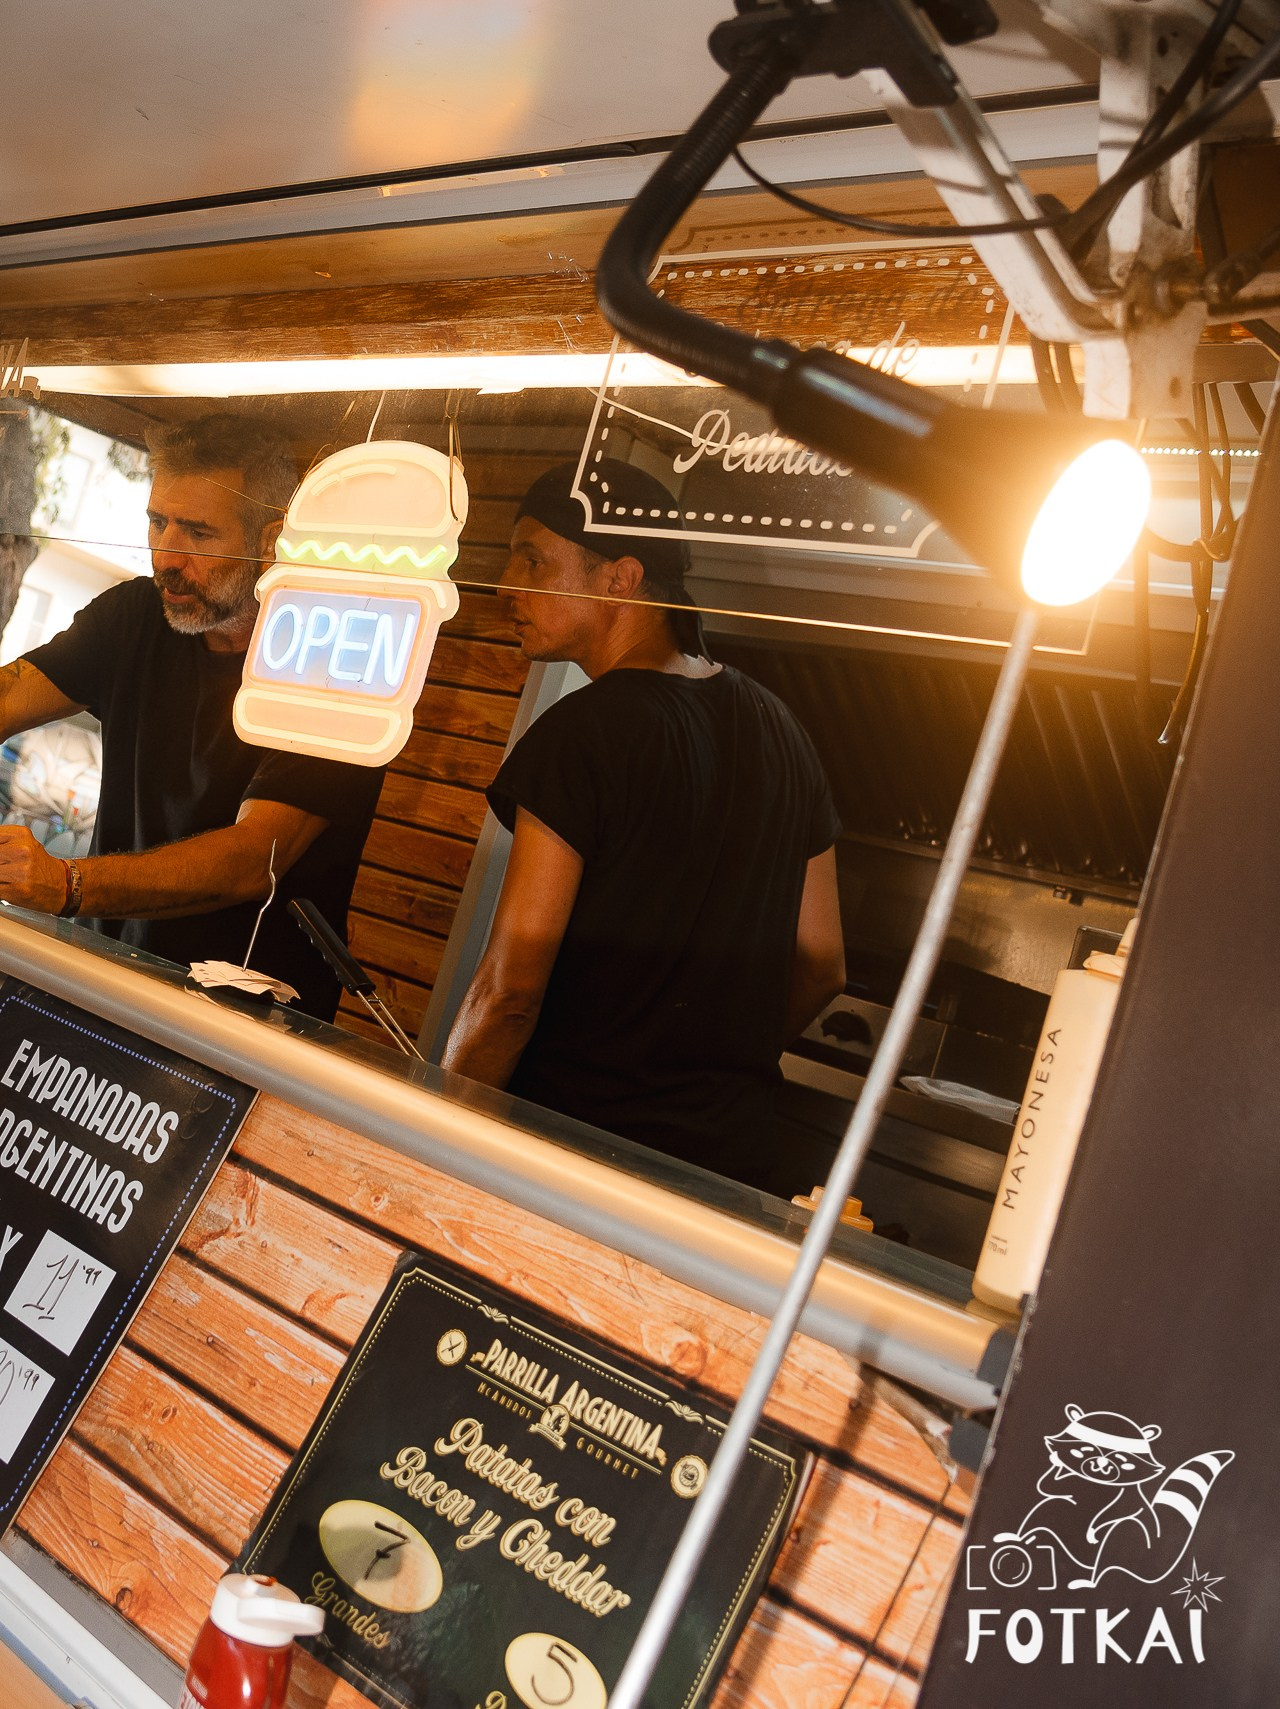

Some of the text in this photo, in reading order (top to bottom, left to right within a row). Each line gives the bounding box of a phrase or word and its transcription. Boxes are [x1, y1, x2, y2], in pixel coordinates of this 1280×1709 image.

[262, 603, 416, 686] OPEN
[1, 1039, 179, 1165] EMPANADAS
[1002, 1028, 1062, 1210] MAYONESA
[480, 1338, 663, 1460] PARRILLA ARGENTINA
[433, 1417, 617, 1547] Patatas con
[576, 1436, 639, 1479] GOURMET
[365, 1520, 413, 1582] 7
[379, 1446, 632, 1618] Bacon y Cheddar
[303, 1570, 390, 1650] Grandes
[531, 1641, 578, 1706] 5
